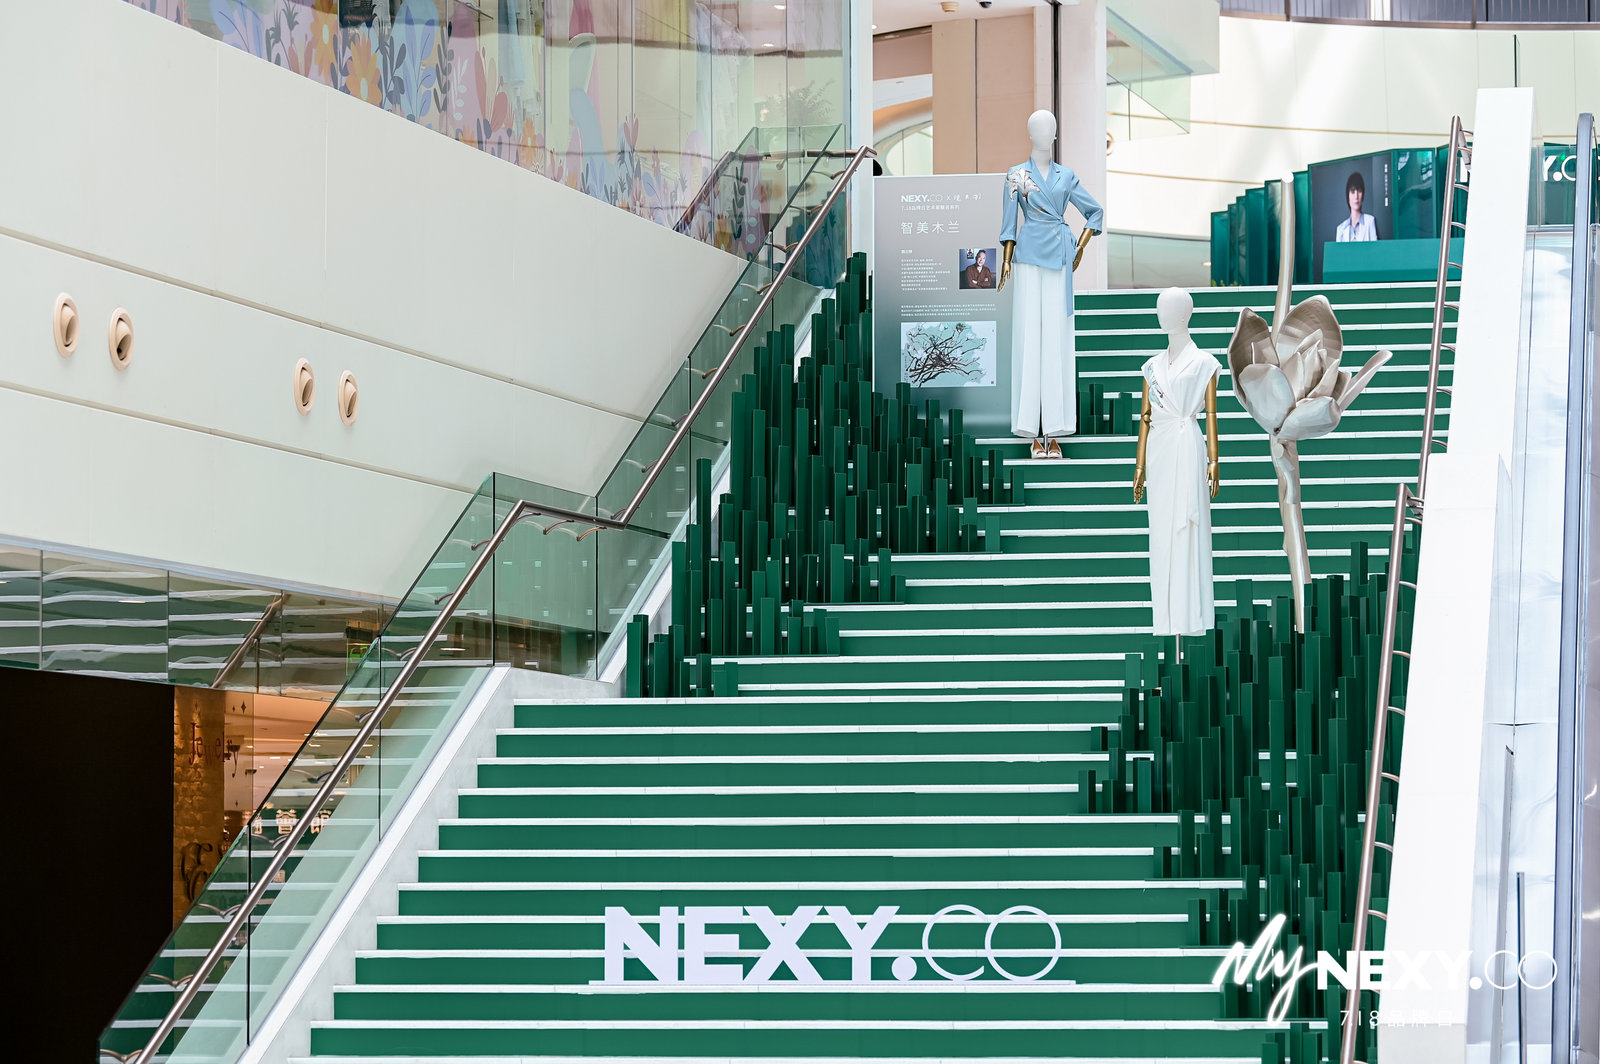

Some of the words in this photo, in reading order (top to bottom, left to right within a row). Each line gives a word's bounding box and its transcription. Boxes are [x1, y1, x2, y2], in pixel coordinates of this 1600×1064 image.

[901, 194, 943, 203] NEXY.CO
[901, 220, 960, 235] 智美木兰
[604, 904, 1062, 982] NEXY.CO
